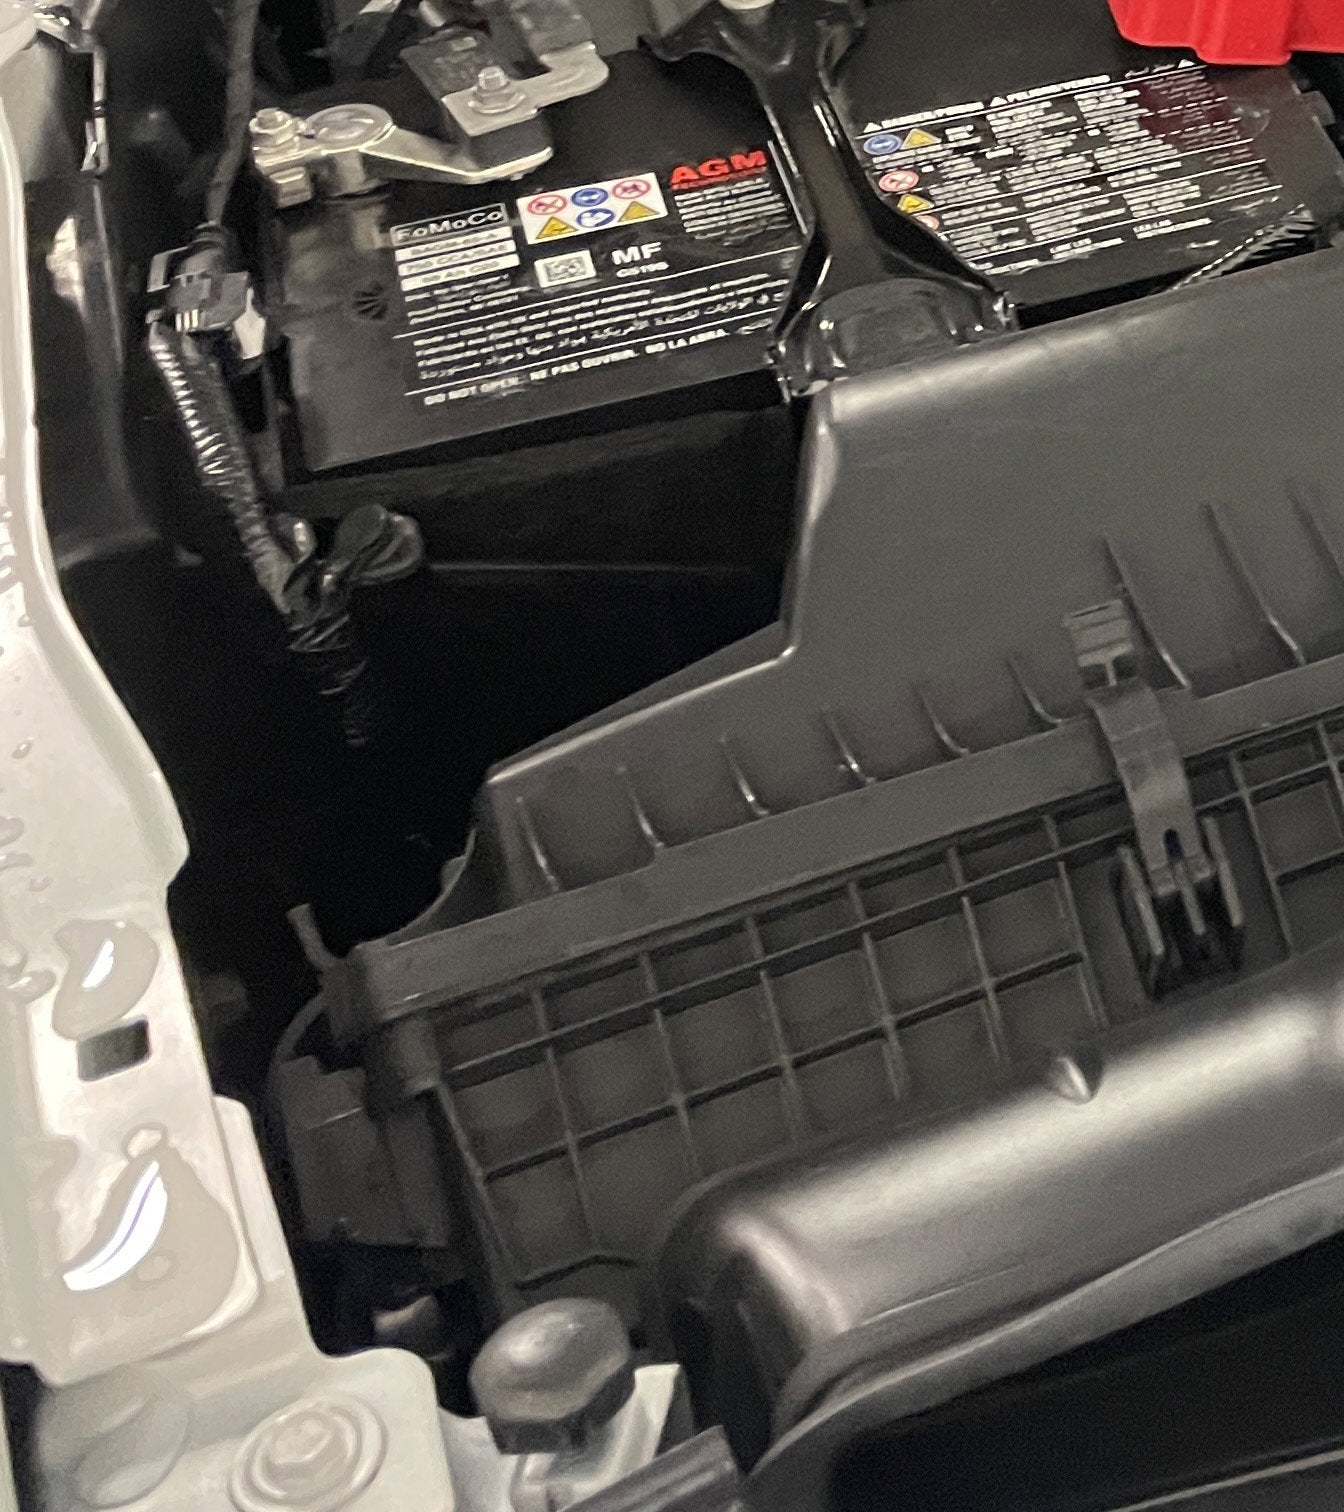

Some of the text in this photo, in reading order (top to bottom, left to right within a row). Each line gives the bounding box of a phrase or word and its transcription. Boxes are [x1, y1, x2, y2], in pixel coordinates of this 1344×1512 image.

[670, 149, 768, 186] AGM
[396, 210, 504, 241] FoMoCo
[611, 241, 662, 266] MF
[667, 338, 688, 350] LA
